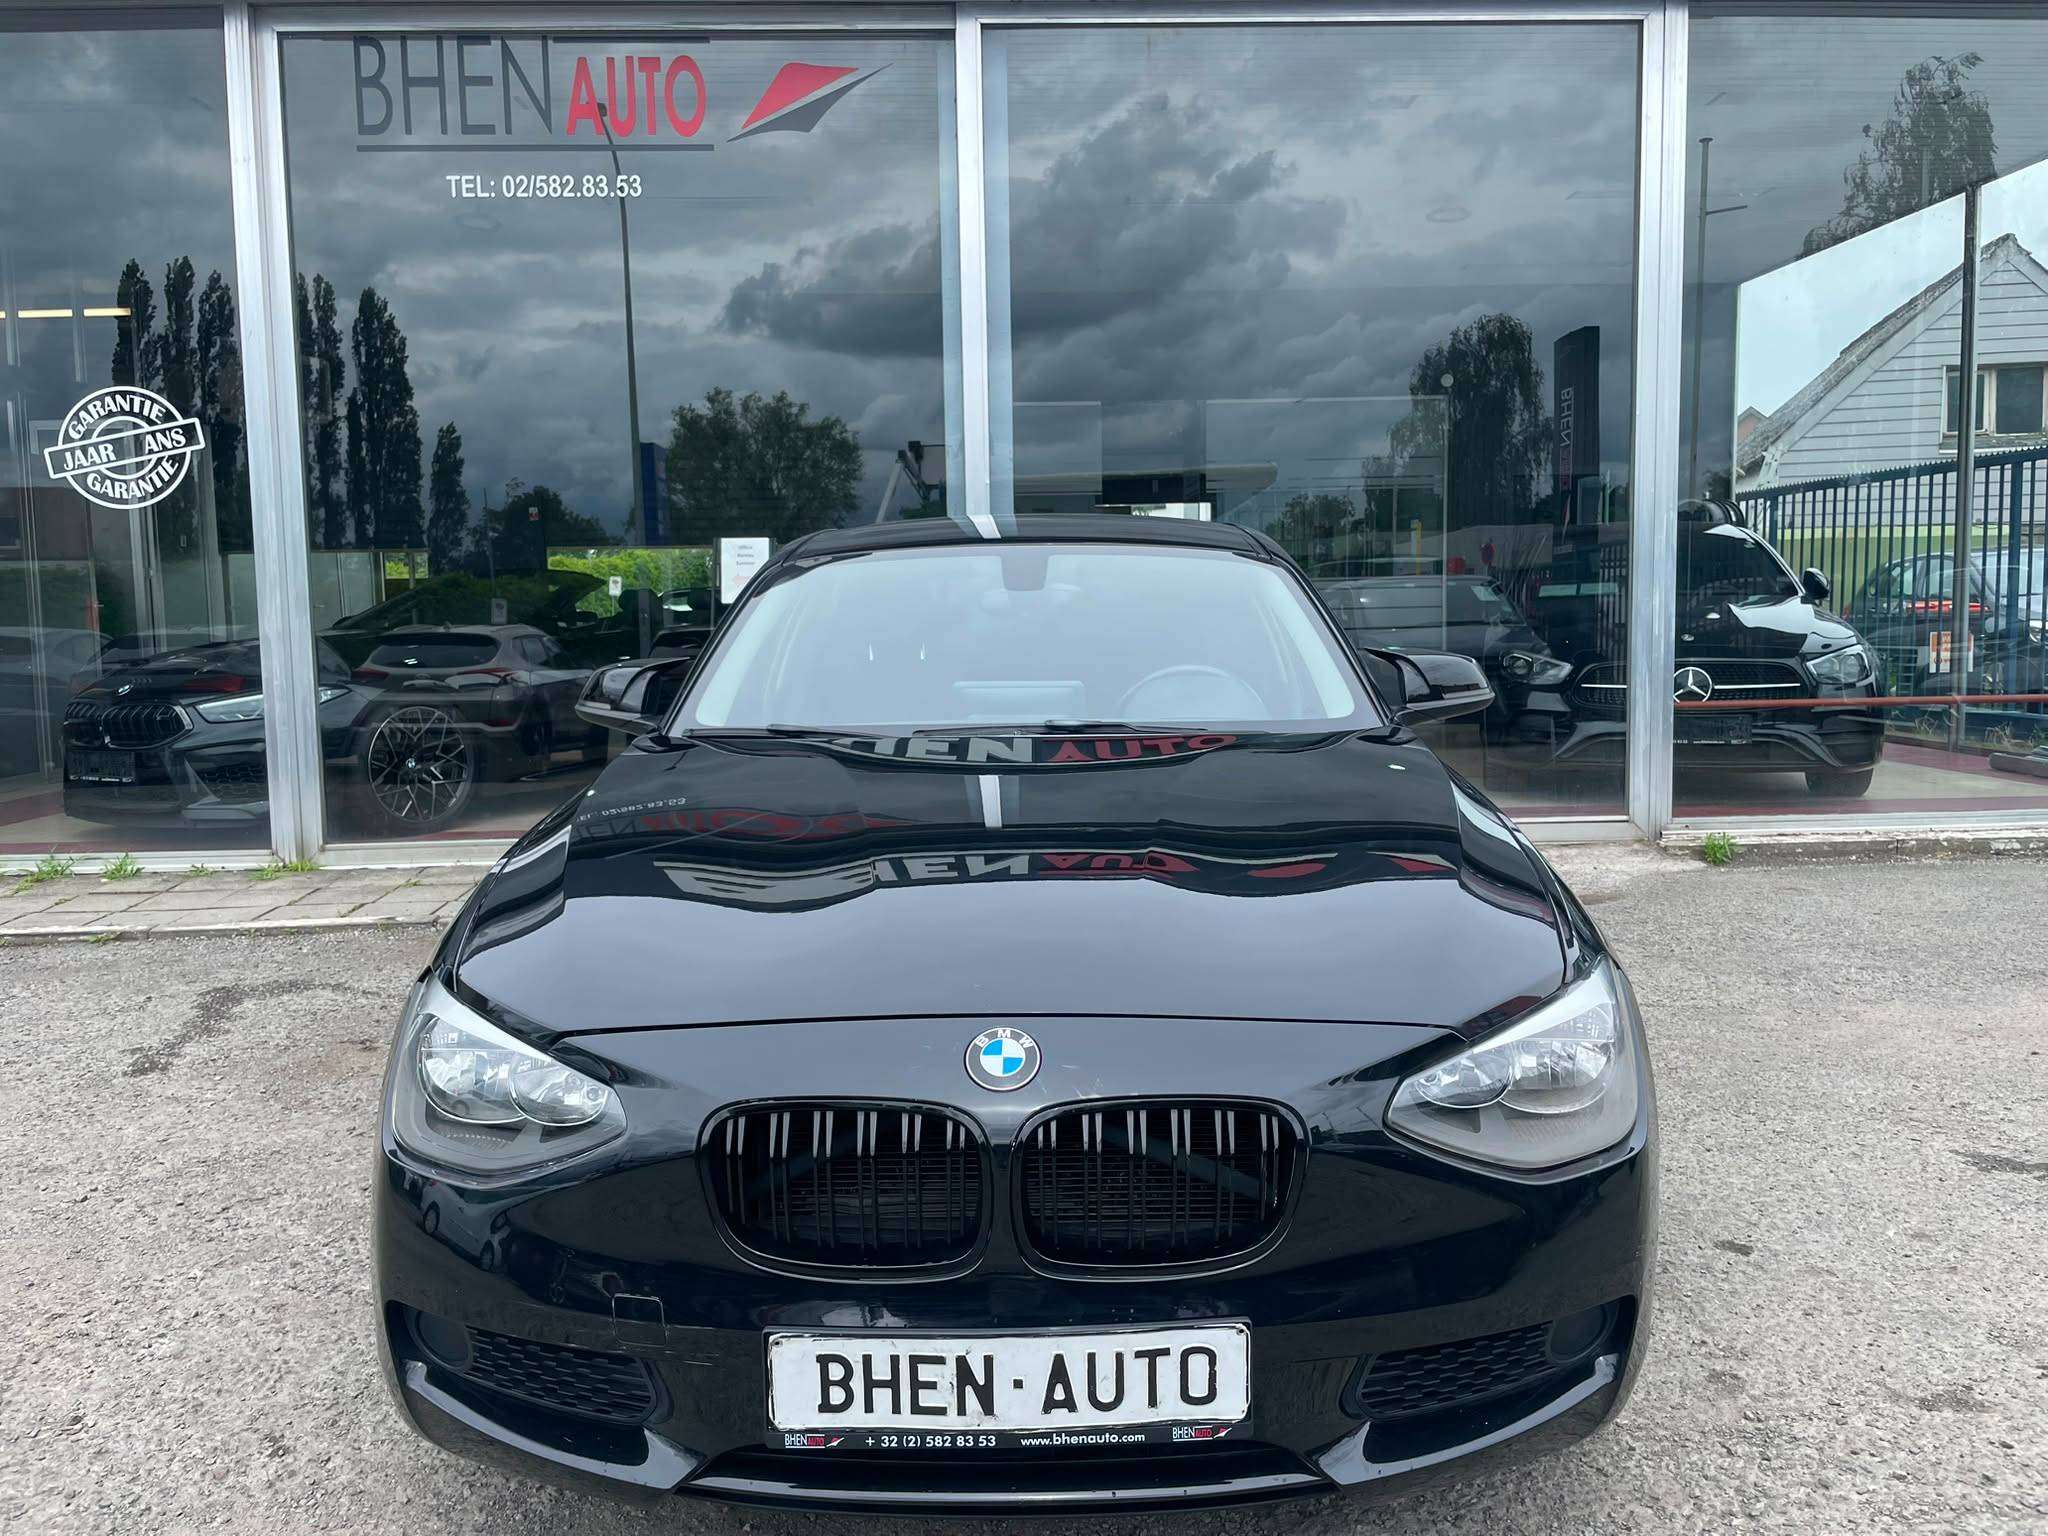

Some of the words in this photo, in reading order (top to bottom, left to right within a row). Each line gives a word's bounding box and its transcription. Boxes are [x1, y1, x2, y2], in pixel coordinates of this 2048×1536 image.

[353, 35, 552, 135] BHEN
[566, 54, 706, 137] AUTO
[446, 175, 496, 198] TEL:
[502, 174, 642, 199] 02/582.83.53
[68, 394, 166, 440] GARANTIE
[64, 443, 116, 470] JAAR
[145, 428, 187, 454] ANS
[87, 455, 179, 499] GARANTIE
[975, 1029, 1033, 1048] BMW
[816, 1352, 997, 1416] BHEN
[1041, 1346, 1217, 1414] AUTO
[785, 1433, 807, 1446] BHEN
[881, 1436, 898, 1447] 32
[903, 1435, 921, 1447] (2)
[926, 1435, 951, 1447] 582
[956, 1435, 974, 1447] 83
[978, 1435, 996, 1447] 53
[1021, 1433, 1145, 1446] www.bhenauto.com
[1172, 1427, 1195, 1439] BHEN
